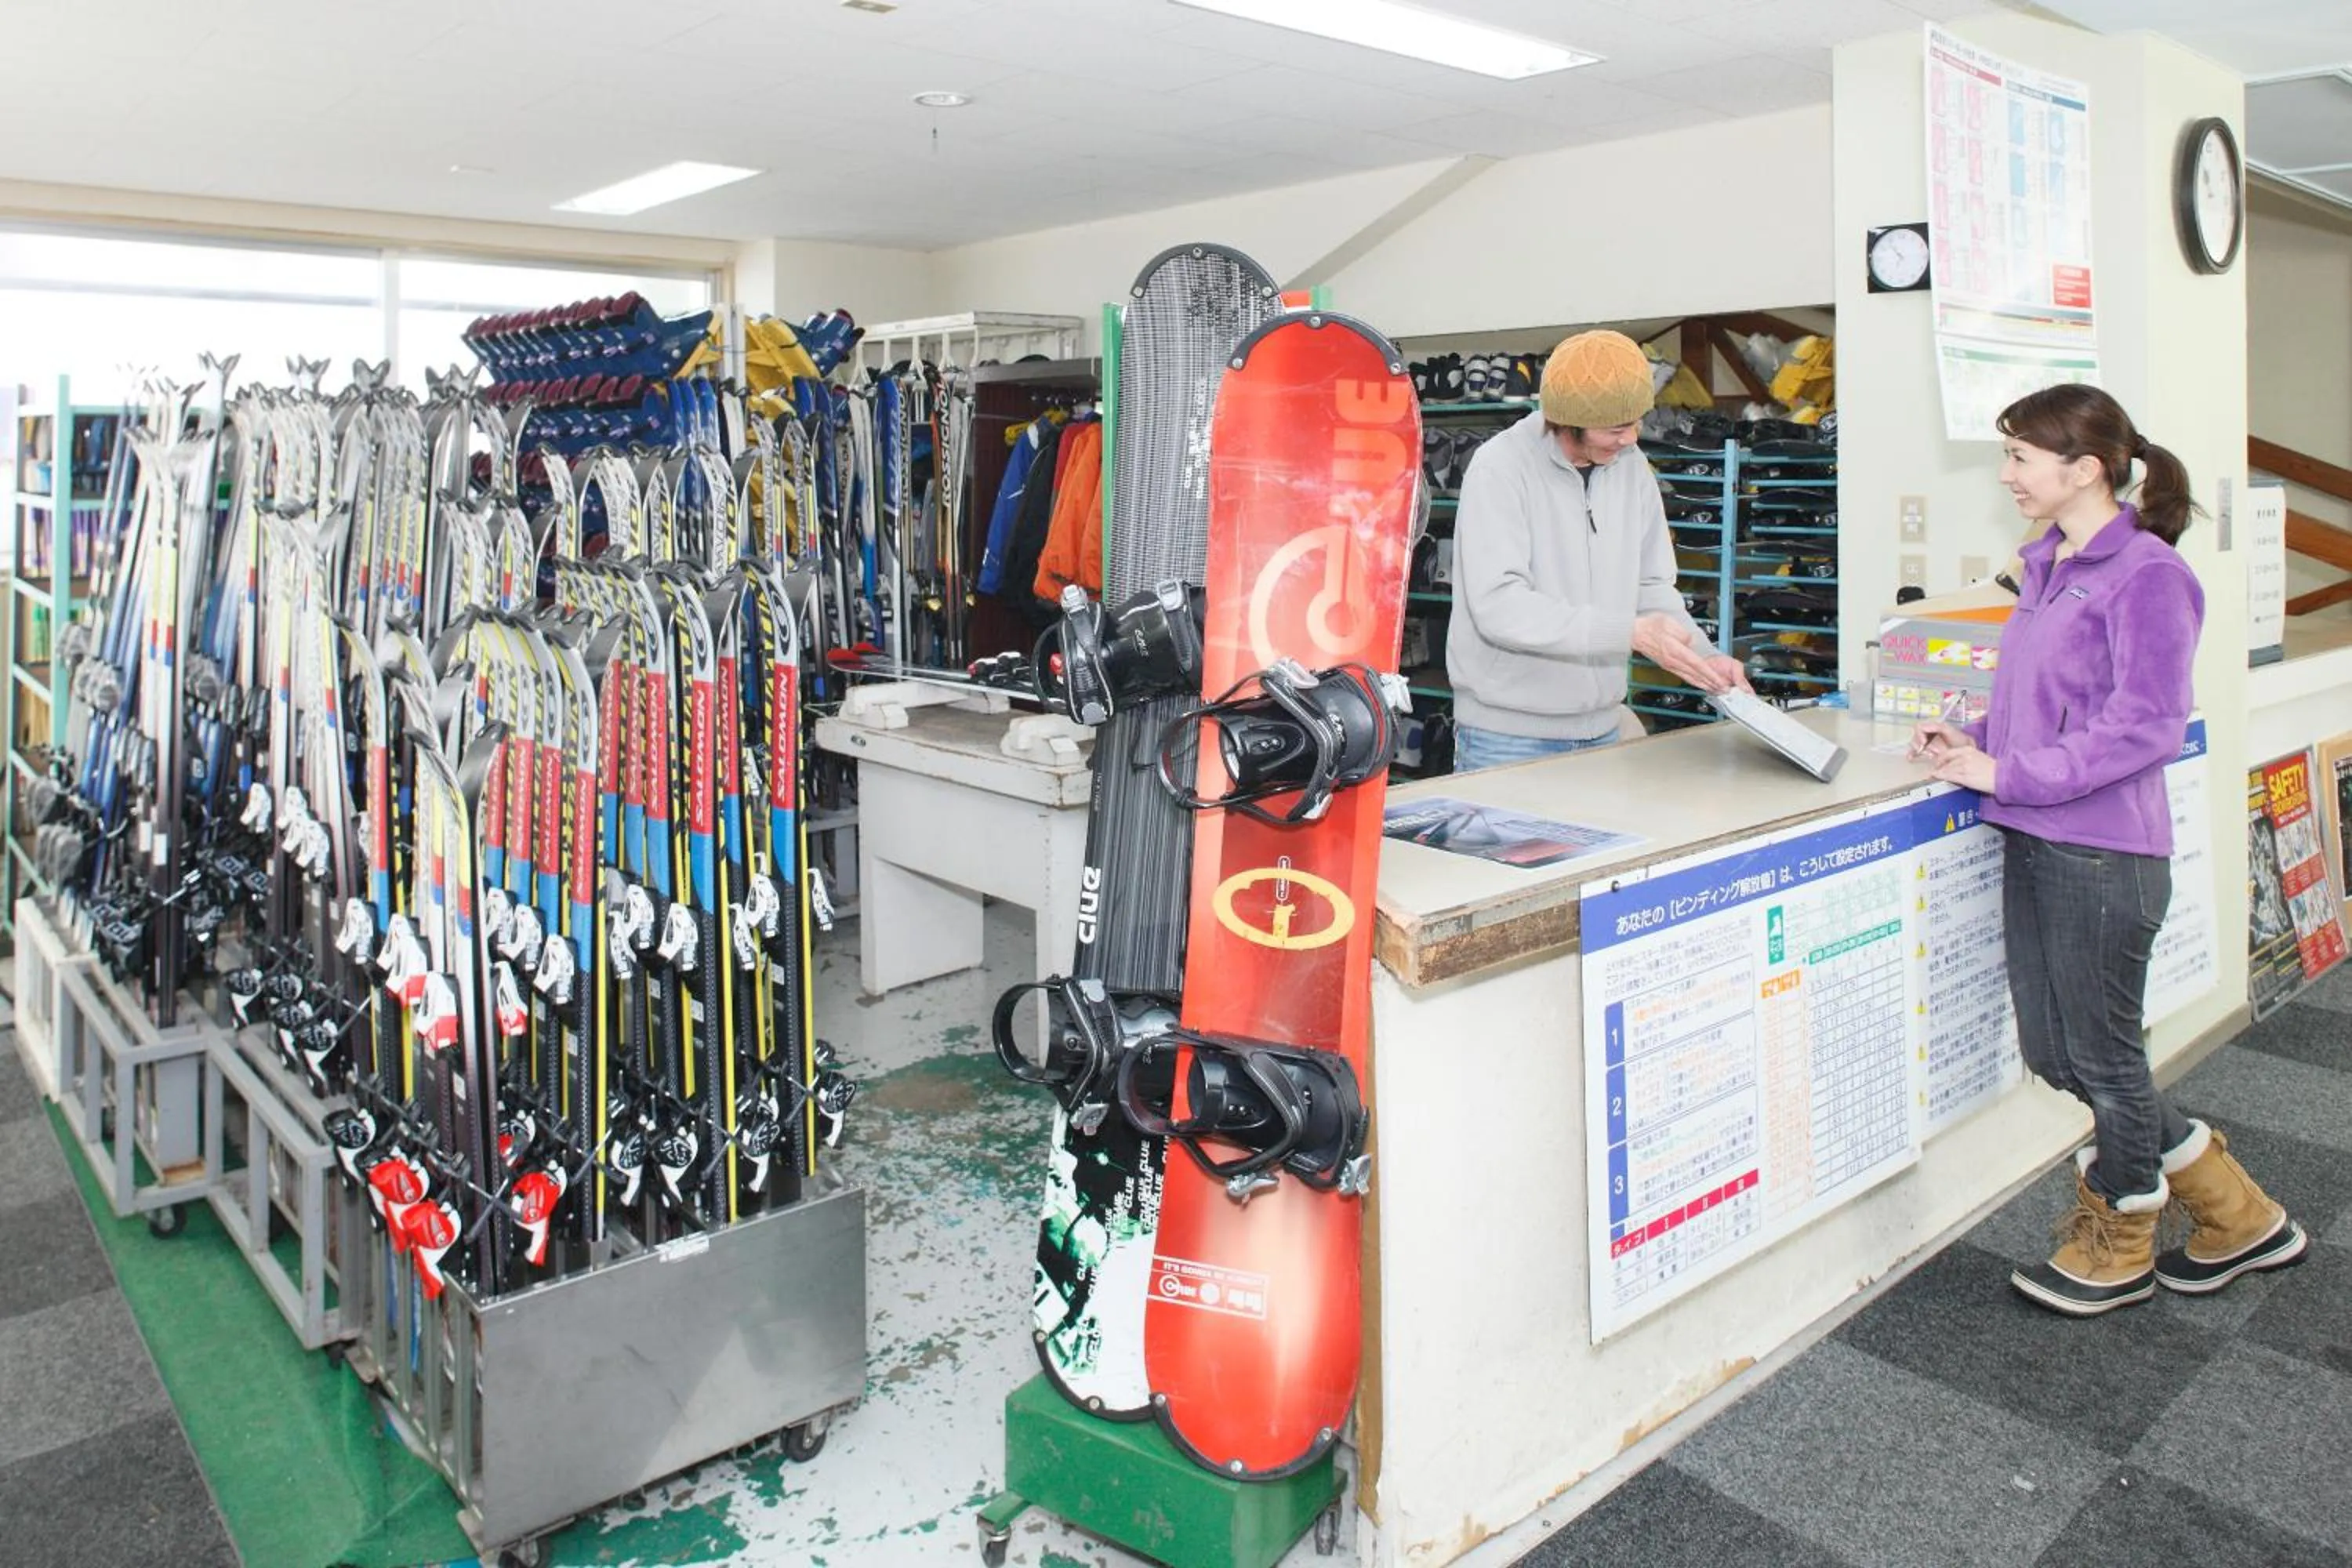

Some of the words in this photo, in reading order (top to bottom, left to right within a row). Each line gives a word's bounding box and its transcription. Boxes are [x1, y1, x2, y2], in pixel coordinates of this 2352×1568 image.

[938, 381, 951, 508] ROSSIGNOL
[1882, 633, 1927, 651] QUICK
[1894, 652, 1929, 666] WAX
[630, 671, 640, 799] SALOMON
[720, 666, 730, 788] SALOMON
[777, 673, 788, 802] SALOMON
[648, 681, 657, 813] SALOMON
[695, 689, 705, 826] SALOMON
[2268, 760, 2305, 802] SAFETY
[1611, 1028, 1618, 1047] 1
[1613, 1097, 1622, 1116] 2
[1140, 1139, 1150, 1171] CLUE
[1124, 1177, 1134, 1209] CLUE
[1614, 1175, 1624, 1195] 3
